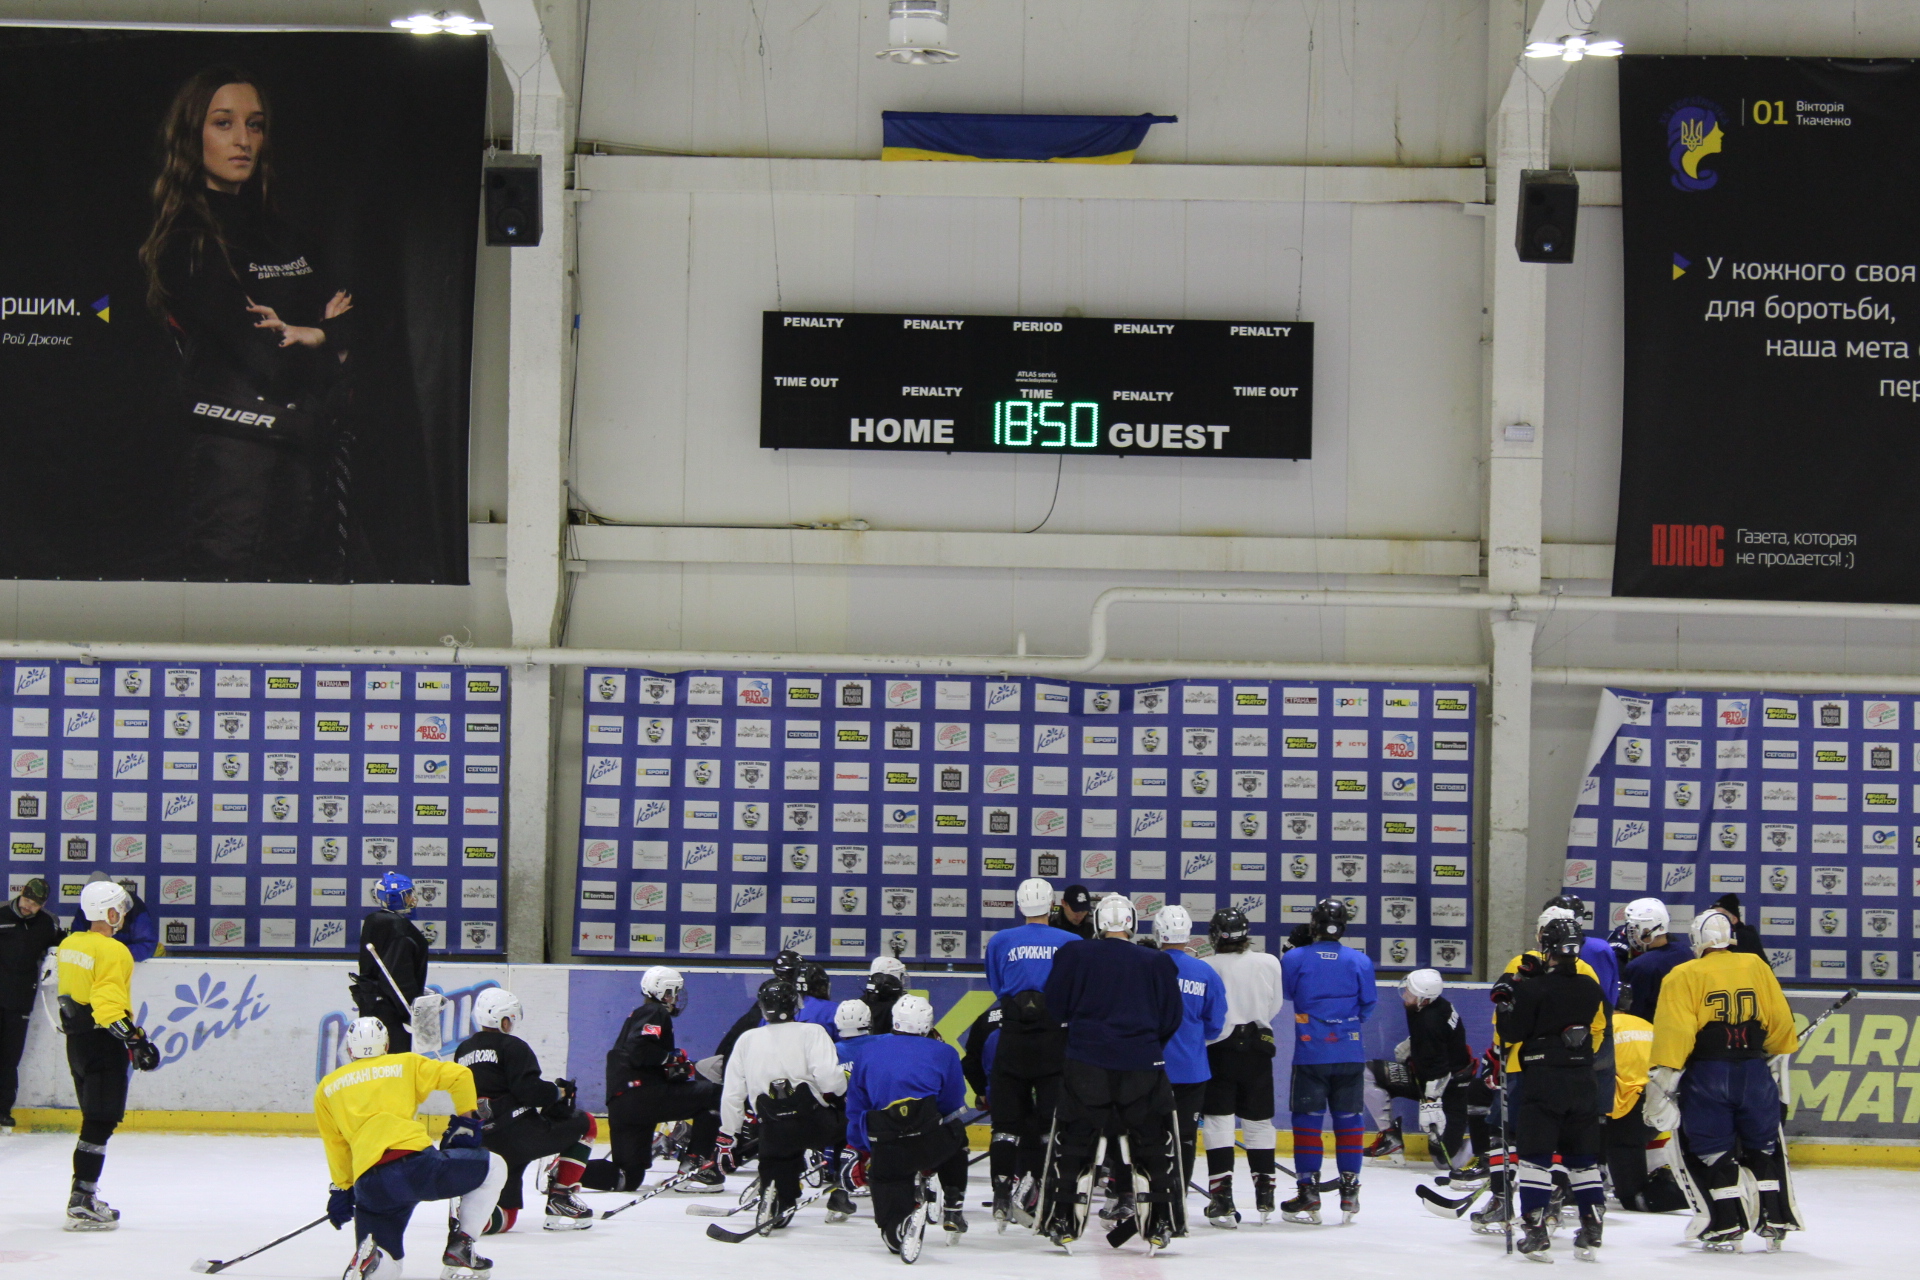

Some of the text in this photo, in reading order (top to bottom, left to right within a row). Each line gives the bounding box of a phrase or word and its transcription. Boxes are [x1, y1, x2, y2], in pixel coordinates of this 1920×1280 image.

[1753, 101, 1788, 124] 01
[1797, 100, 1844, 114] Вікторія
[1796, 113, 1851, 126] Ткаченко
[1707, 257, 1915, 282] У кожного своя
[1705, 295, 1895, 324] для боротьби,
[784, 317, 844, 327] PENALTY
[904, 319, 964, 330] PENALTY
[1013, 321, 1062, 332] PERIOD
[1114, 324, 1174, 334] PENALTY
[1231, 326, 1291, 336] PENALTY
[3, 333, 72, 346] Рой Джонс
[1767, 340, 1909, 358] наша мета
[774, 377, 840, 388] TIME OUT
[902, 386, 962, 396] PENALTY
[1020, 389, 1053, 399] TIME
[1113, 391, 1173, 401] PENALTY
[1234, 386, 1298, 397] TIME OUT
[851, 418, 954, 443] HOME
[994, 401, 1098, 447] 18:50
[1109, 423, 1230, 449] GUEST
[1738, 529, 1856, 548] Газета, которая
[1652, 524, 1724, 567] ПЛЮС
[1737, 553, 1755, 564] не
[1759, 552, 1841, 567] продается!
[1704, 988, 1760, 1025] 30
[364, 1047, 373, 1056] 22
[372, 1064, 403, 1080] ВОВКИ
